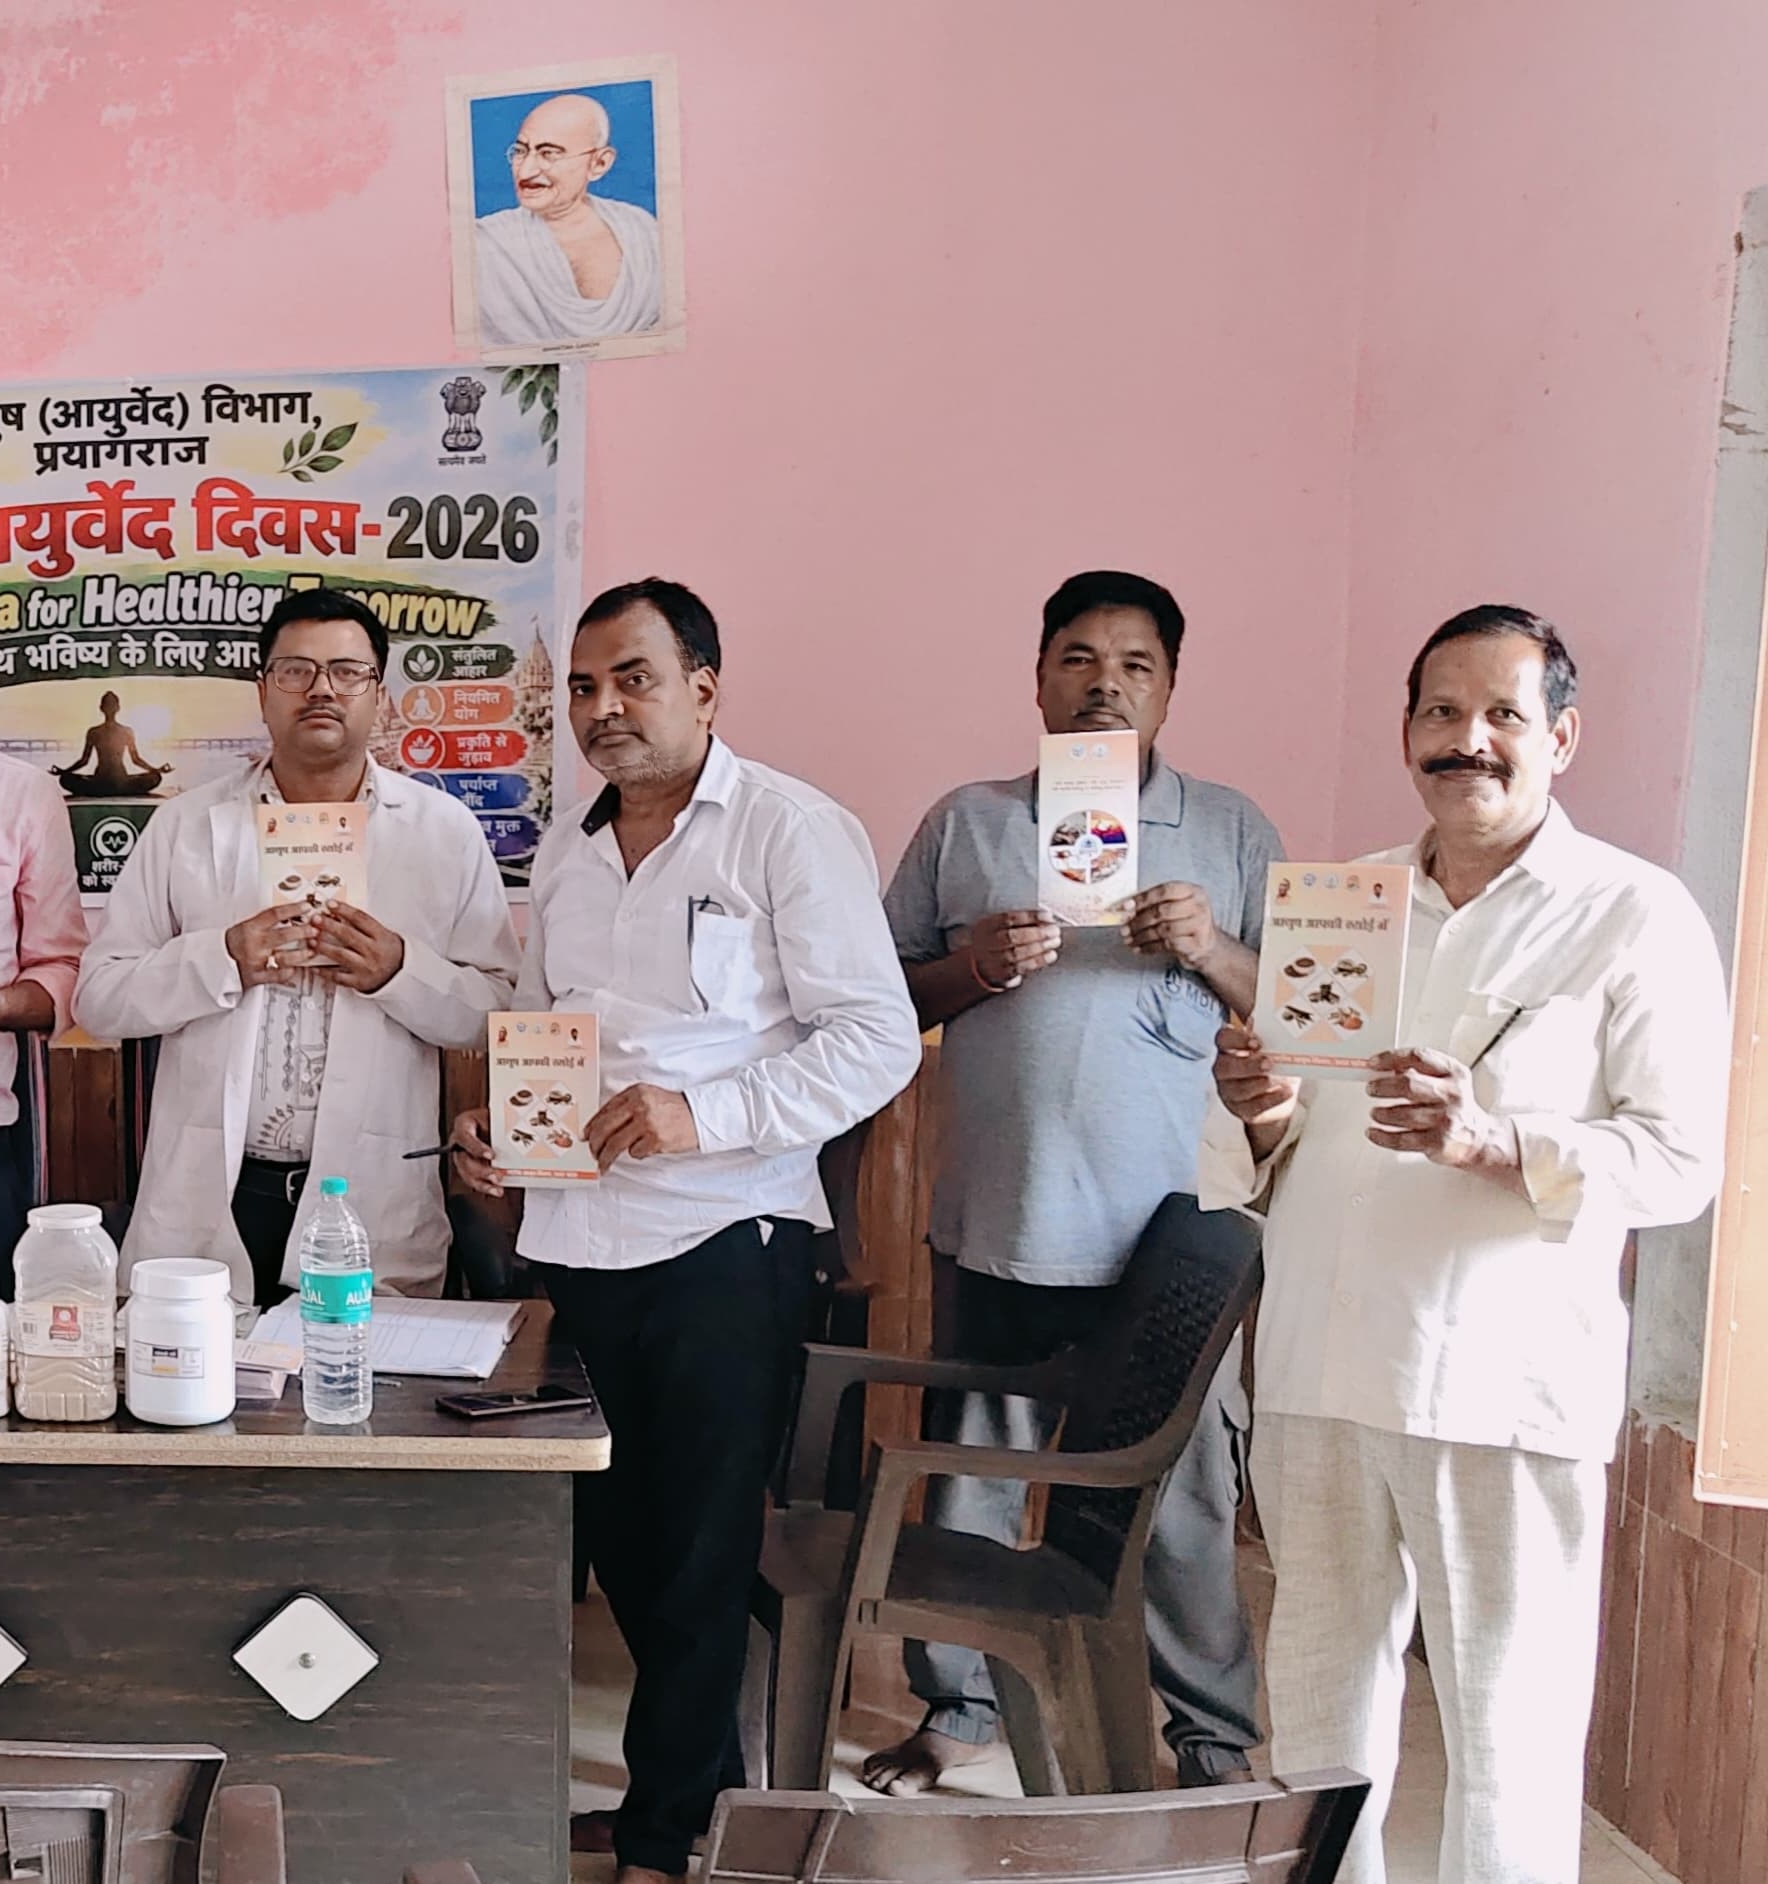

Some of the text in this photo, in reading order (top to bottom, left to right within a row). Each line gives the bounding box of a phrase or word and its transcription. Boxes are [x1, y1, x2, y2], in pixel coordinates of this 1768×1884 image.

[39, 386, 190, 438] (आयुर्वेद)
[202, 383, 323, 430] विभाग,
[34, 435, 209, 476] प्रयागराज
[28, 589, 74, 628] for
[83, 573, 283, 627] Healthier
[288, 574, 483, 638] Torrow
[25, 629, 112, 671] भविष्य
[118, 632, 149, 668] के
[152, 629, 209, 672] लिए
[451, 648, 498, 667] संतुलित
[453, 707, 479, 721] योग
[495, 732, 507, 748] से
